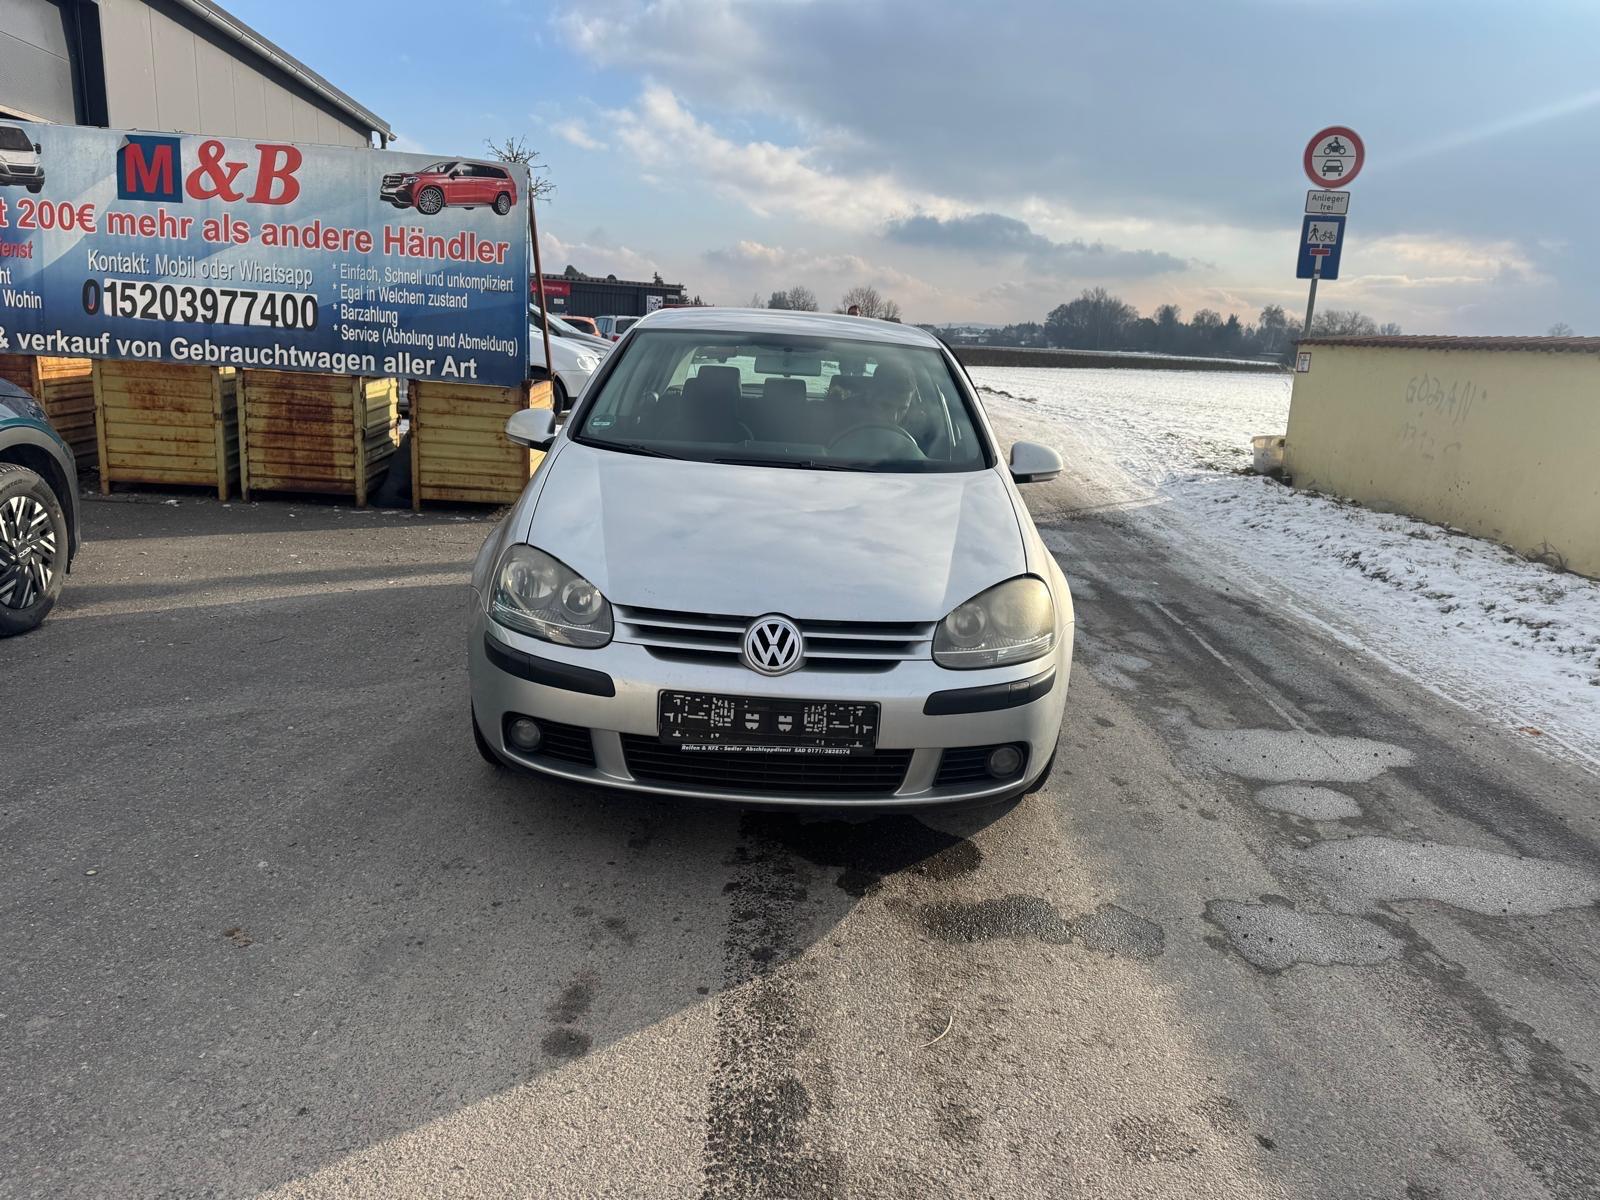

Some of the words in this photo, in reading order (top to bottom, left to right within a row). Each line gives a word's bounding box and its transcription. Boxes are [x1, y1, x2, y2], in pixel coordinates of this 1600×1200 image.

[1311, 194, 1345, 203] Anlieger
[1320, 202, 1334, 211] frei
[17, 198, 96, 233] 200€
[107, 208, 194, 239] mehr
[201, 212, 250, 244] als
[260, 219, 373, 254] andere
[382, 223, 510, 264] Händler
[87, 249, 150, 275] Kontakt:
[155, 254, 196, 279] Mobil
[200, 258, 235, 280] oder
[240, 260, 313, 289] Whatsapp
[340, 263, 381, 283] Einfach,
[384, 266, 422, 285] Schnell
[425, 271, 444, 287] und
[447, 273, 513, 294] unkompliziert
[2, 289, 42, 309] Wohin
[82, 278, 319, 332] 015203977400
[340, 283, 363, 304] Egal
[366, 286, 375, 301] in
[378, 286, 425, 305] Welchem
[428, 293, 468, 309] zustand
[341, 303, 398, 327] Barzahlung
[17, 329, 110, 355] verkauf
[116, 339, 162, 359] von
[170, 337, 375, 373] Gebrauchtwagen
[383, 352, 435, 376] aller
[440, 355, 477, 379] Art
[341, 324, 379, 343] Service
[382, 327, 434, 350] (Abholung
[437, 333, 455, 348] und
[458, 333, 518, 357] Abmeldung)
